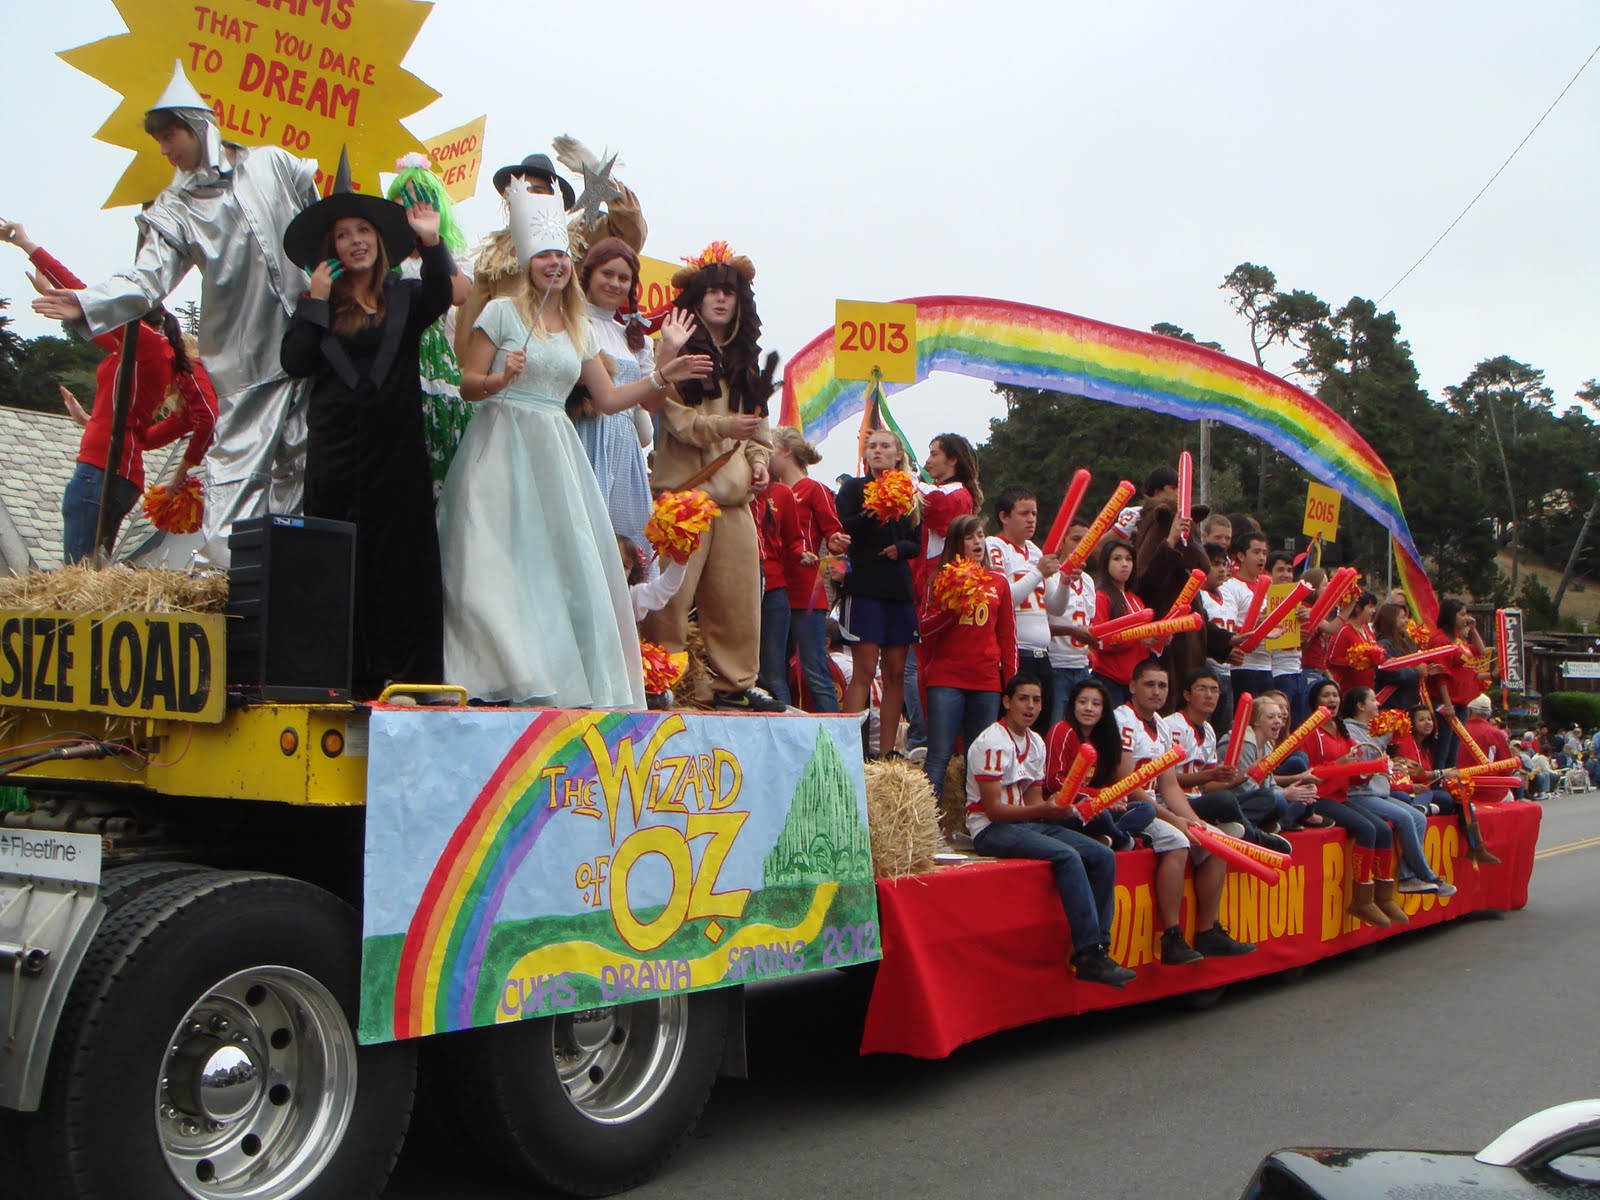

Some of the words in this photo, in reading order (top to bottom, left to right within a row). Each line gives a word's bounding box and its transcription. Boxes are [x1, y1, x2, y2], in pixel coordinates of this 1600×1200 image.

[194, 6, 259, 44] THAT
[274, 29, 313, 62] YOU
[318, 47, 376, 86] DARE
[188, 41, 223, 73] TO
[238, 52, 361, 127] DREAM
[281, 124, 311, 151] DO
[431, 134, 477, 162] RONCO
[839, 320, 909, 354] 2013
[1076, 518, 1106, 557] BRONCO
[1103, 486, 1130, 523] POWER
[1307, 497, 1335, 523] 2015
[1121, 624, 1158, 640] BRONCO
[1159, 615, 1197, 634] POWER
[1504, 616, 1521, 680] PIZZA
[0, 617, 75, 703] SIZE
[89, 618, 212, 714] LOAD
[983, 748, 1003, 772] 11
[1265, 735, 1299, 765] BRONCO
[1295, 710, 1326, 739] POWER
[540, 765, 603, 820] THE
[1099, 772, 1140, 805] BRONCO
[1139, 748, 1180, 780] POWER
[11, 836, 77, 861] Fleetline
[1247, 847, 1283, 868] POWER
[610, 811, 751, 952] OZ
[1219, 865, 1305, 944] UNION
[501, 971, 577, 1016] CUHS
[601, 958, 692, 998] DRAMA
[728, 939, 806, 980] SPRING
[822, 921, 877, 962] 2012
